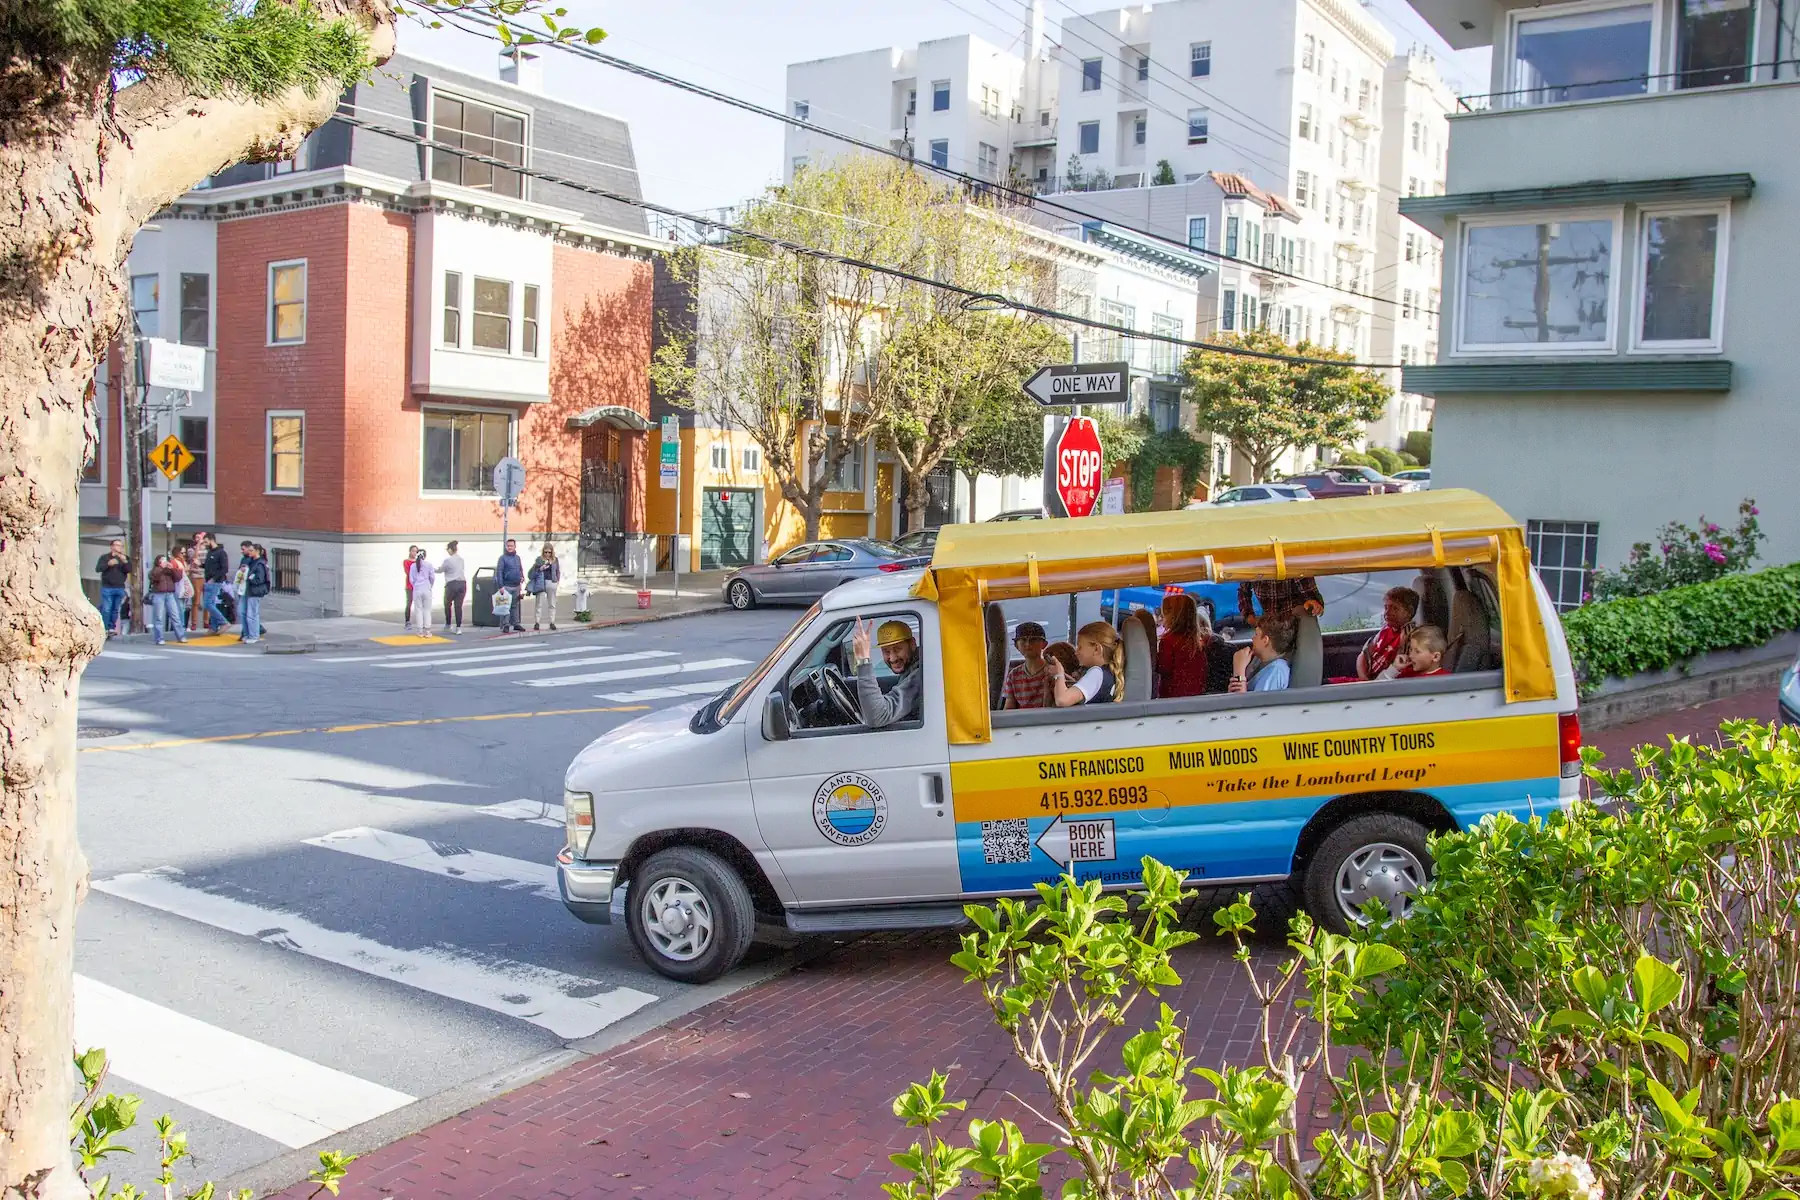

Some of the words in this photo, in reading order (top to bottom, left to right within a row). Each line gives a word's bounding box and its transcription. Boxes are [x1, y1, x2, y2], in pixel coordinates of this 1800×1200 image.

[1052, 377, 1081, 393] ONE
[1086, 375, 1116, 391] WAY
[1060, 448, 1100, 488] STOP
[856, 776, 884, 802] TOURS
[1262, 775, 1290, 790] the
[1295, 768, 1377, 787] Lombard
[1040, 785, 1148, 810] 415.932.6993
[820, 818, 837, 837] SAN
[835, 815, 884, 844] FRANCISCO
[1069, 823, 1106, 841] BOOK
[1070, 841, 1106, 858] HERE
